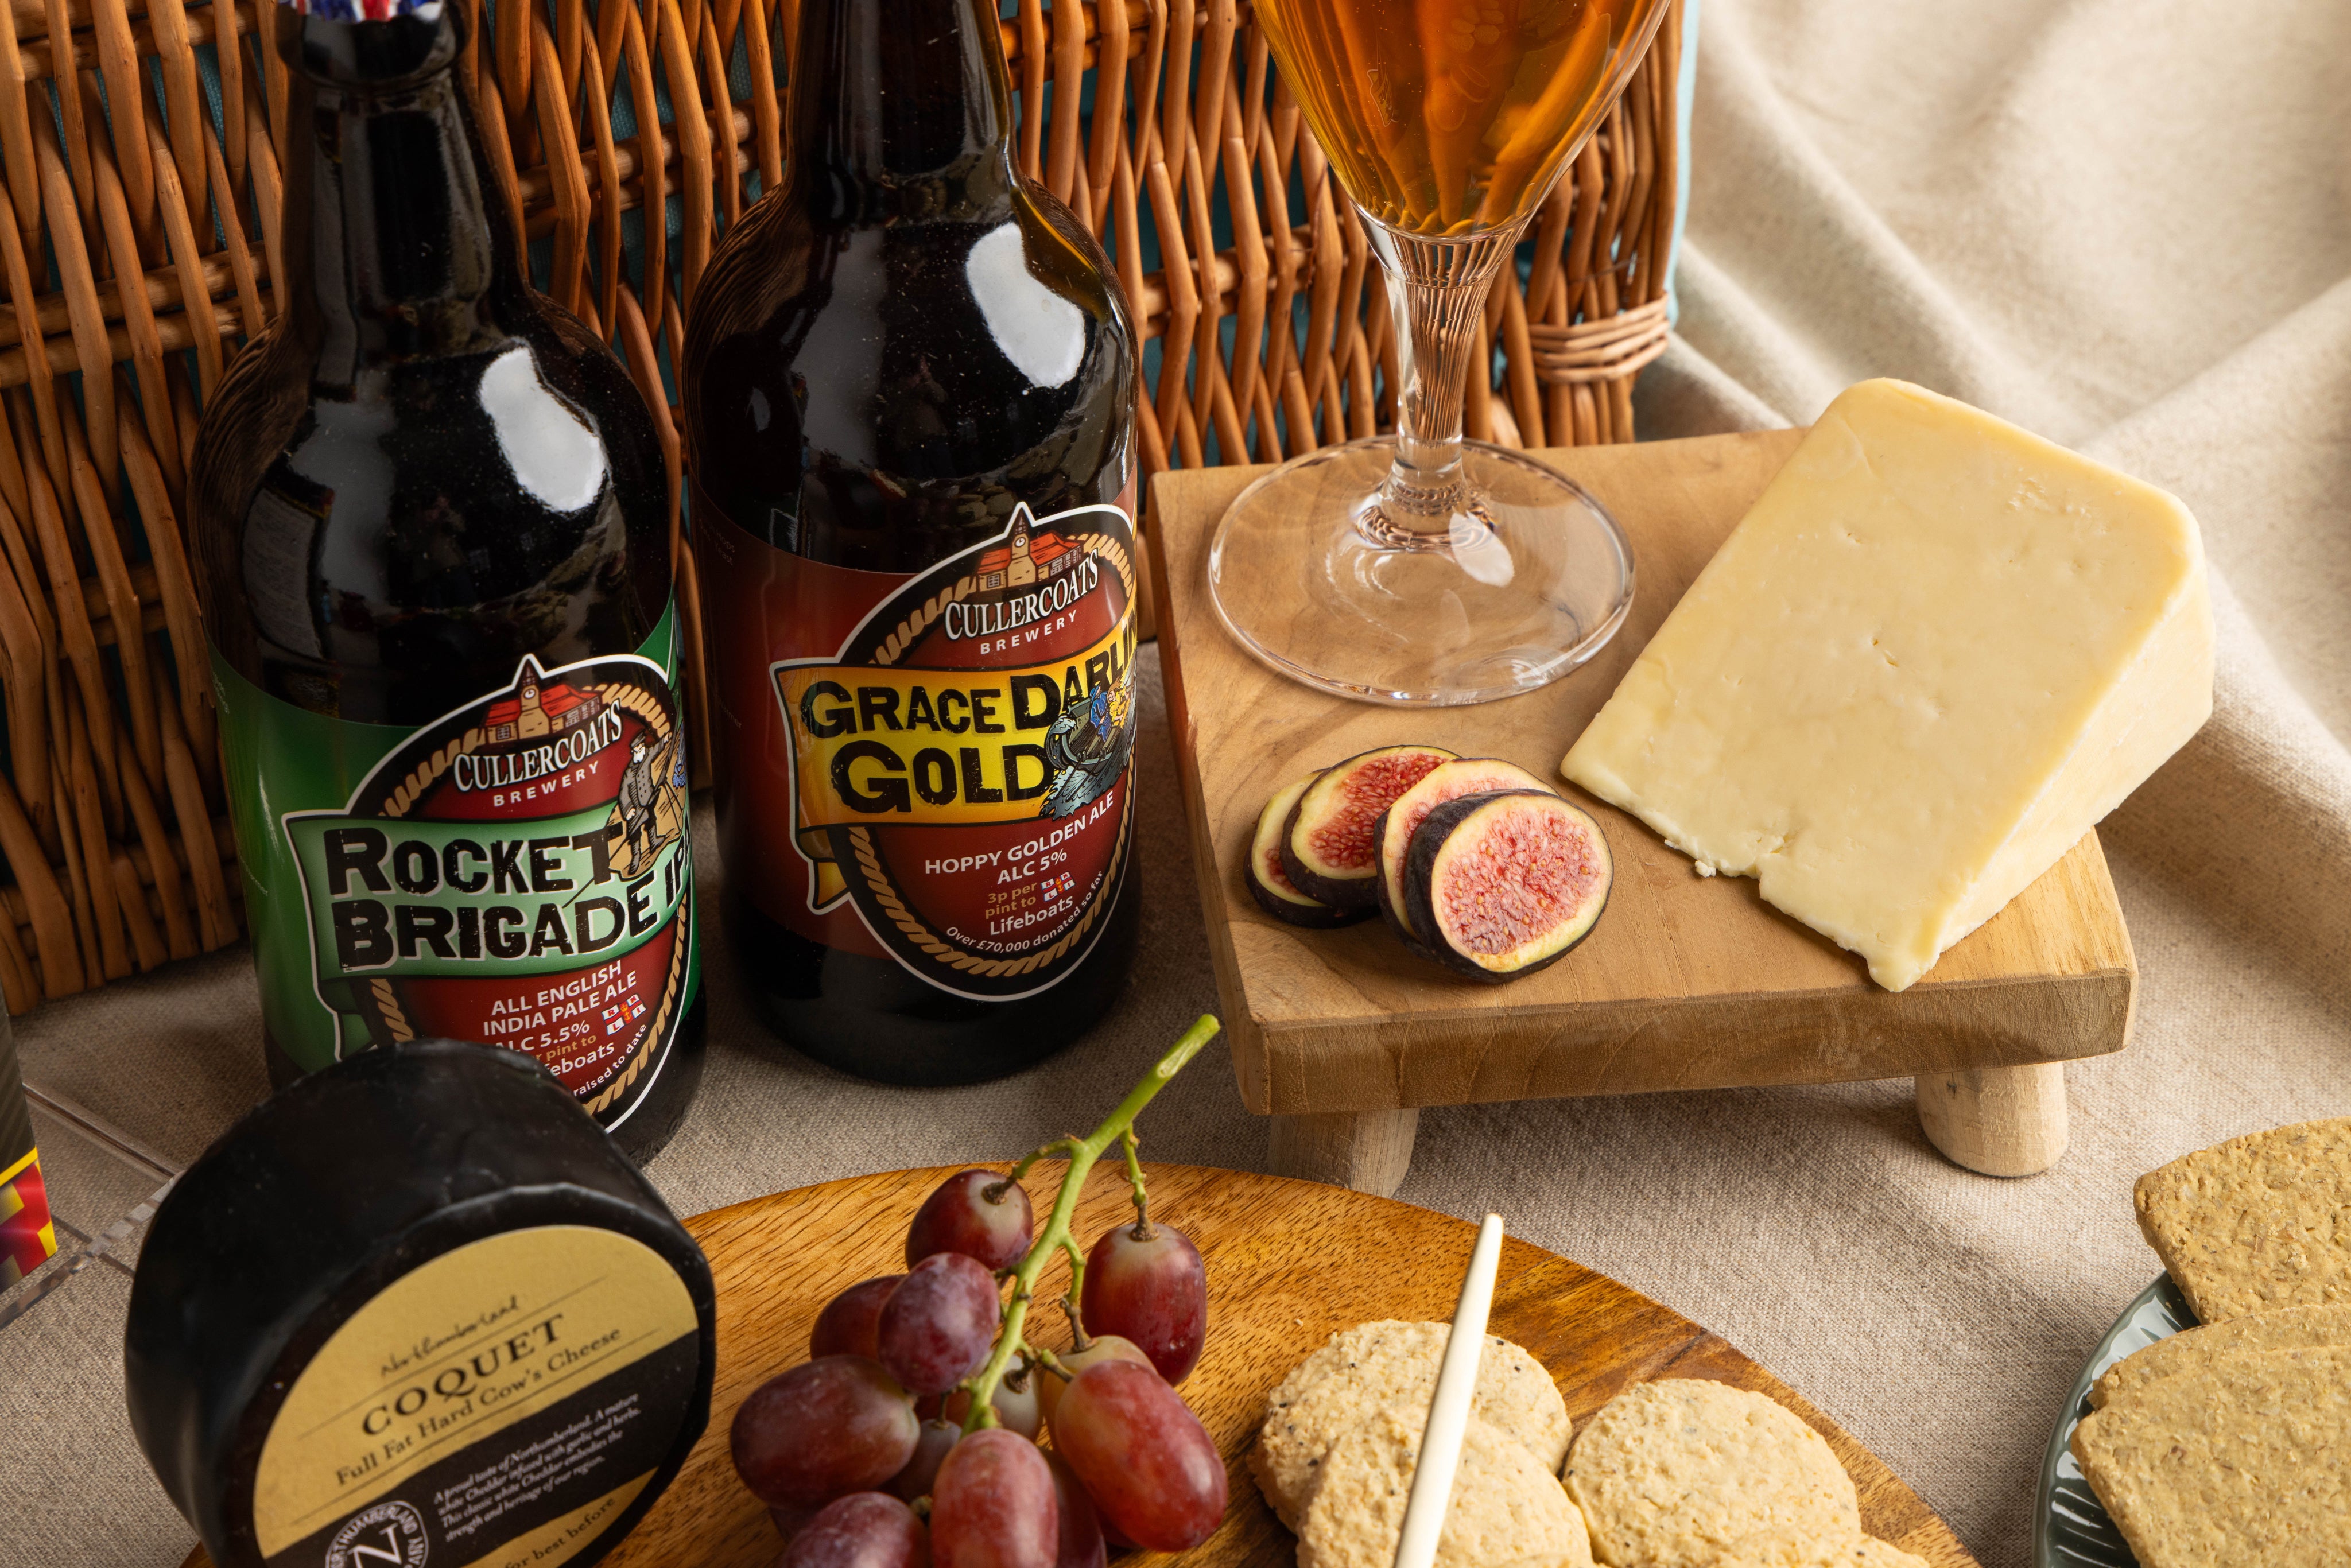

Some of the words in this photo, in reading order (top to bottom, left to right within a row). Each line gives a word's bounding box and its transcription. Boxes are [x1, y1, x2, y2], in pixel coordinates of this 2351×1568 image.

[945, 547, 1099, 641] CULLERCOATS
[980, 610, 1077, 654] BREWERY
[801, 680, 1006, 738] GRACE
[454, 699, 623, 791] CULLERCOATS
[830, 739, 1054, 814] GOLD
[494, 761, 599, 806] BREWERY
[323, 821, 623, 896] ROCKET
[925, 851, 1002, 874] HOPPY
[1008, 814, 1086, 861] GOLDEN
[1089, 791, 1114, 825] ALE
[988, 892, 1007, 907] 3p
[1012, 883, 1037, 901] per
[998, 860, 1035, 885] ALC
[1040, 848, 1068, 871] 5%
[331, 869, 658, 969] BRIGADE
[946, 926, 977, 946] Over
[977, 940, 1030, 953] £70,000
[1033, 906, 1081, 946] donated
[1081, 892, 1092, 907] so
[1091, 870, 1103, 891] far
[986, 903, 1017, 919] pint
[1021, 896, 1037, 907] to
[990, 895, 1073, 936] Lifeboats
[483, 1012, 546, 1036] INDIA
[552, 991, 600, 1023] PALE
[604, 970, 637, 1002] ALE
[491, 996, 532, 1016] ALL
[538, 960, 622, 1007] ENGLISH
[540, 1020, 590, 1047] 5.5%
[545, 1042, 615, 1076] eboats
[546, 1041, 577, 1061] pint
[581, 1035, 597, 1047] to
[574, 1068, 612, 1097] raised
[612, 1055, 626, 1069] to
[626, 1024, 647, 1054] date
[335, 1449, 379, 1485] Full
[383, 1435, 413, 1460] Fat
[418, 1400, 474, 1439] Hard
[480, 1368, 542, 1406] Cow's
[547, 1328, 621, 1372] Cheese
[362, 1314, 564, 1436] COQUET
[434, 1491, 444, 1504] A
[595, 1410, 604, 1423] A
[533, 1538, 567, 1560] best
[565, 1498, 616, 1538] before
